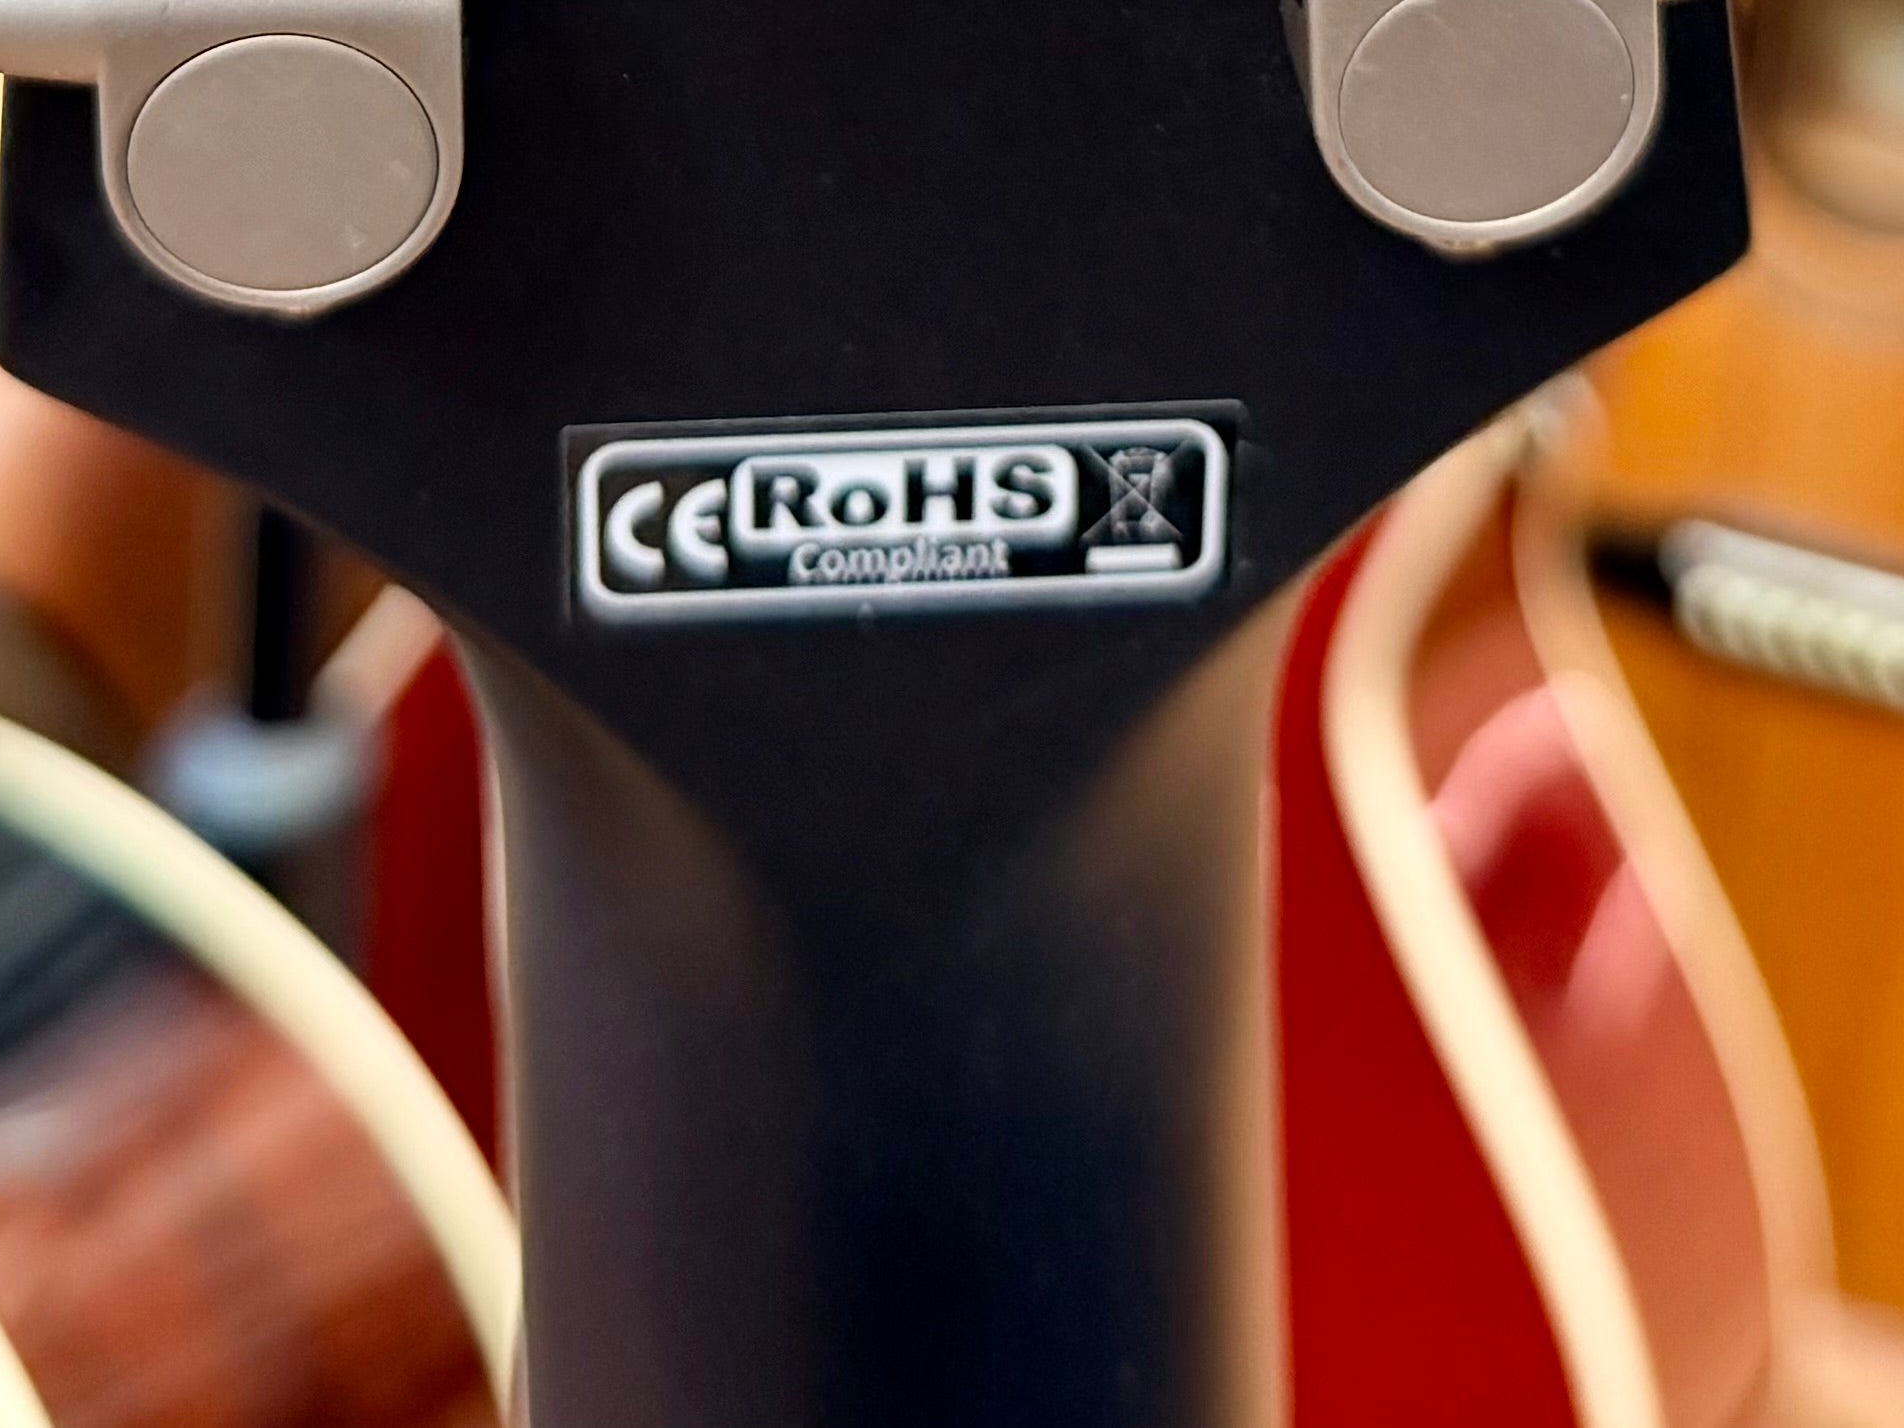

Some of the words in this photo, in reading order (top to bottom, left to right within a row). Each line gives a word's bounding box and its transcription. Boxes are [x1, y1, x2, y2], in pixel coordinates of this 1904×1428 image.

[605, 479, 729, 584] CE
[750, 453, 1056, 532] RoHS
[793, 537, 1010, 584] Compliant
